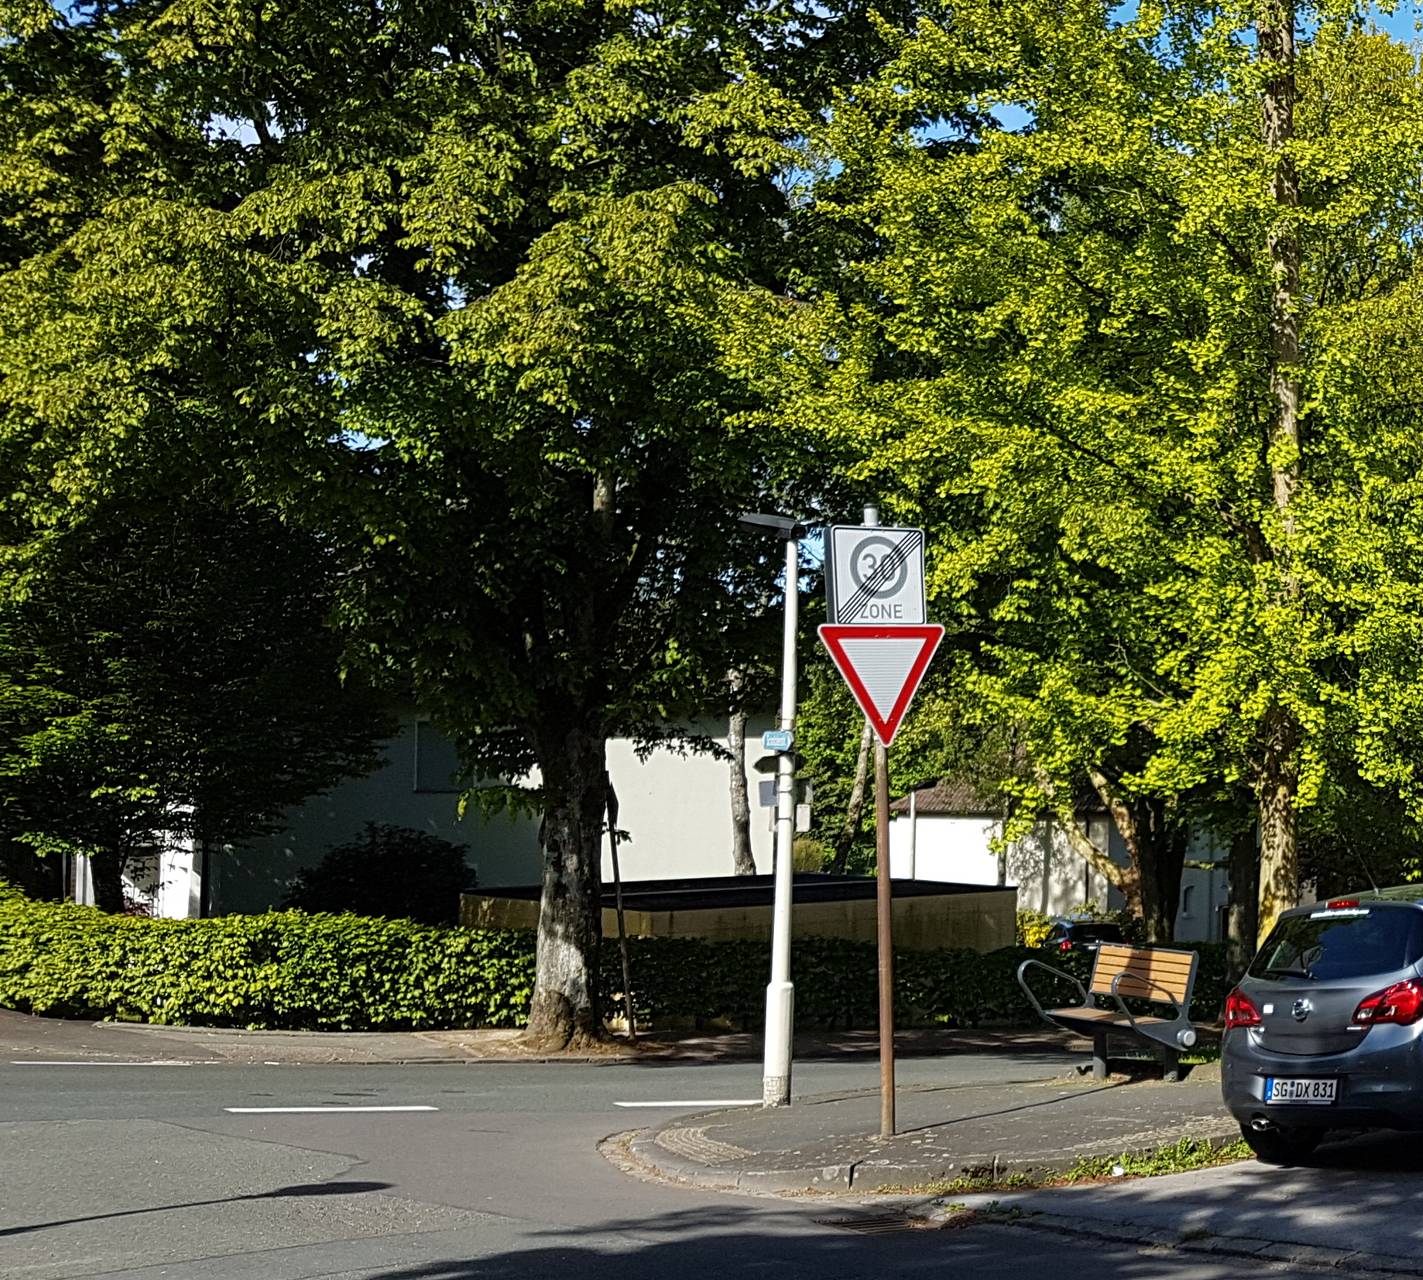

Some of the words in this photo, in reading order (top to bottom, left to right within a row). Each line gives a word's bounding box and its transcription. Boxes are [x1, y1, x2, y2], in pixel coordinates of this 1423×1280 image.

[860, 603, 903, 619] ZONE
[1273, 1081, 1289, 1098] SG
[1295, 1081, 1311, 1098] DX
[1312, 1081, 1334, 1098] 831
